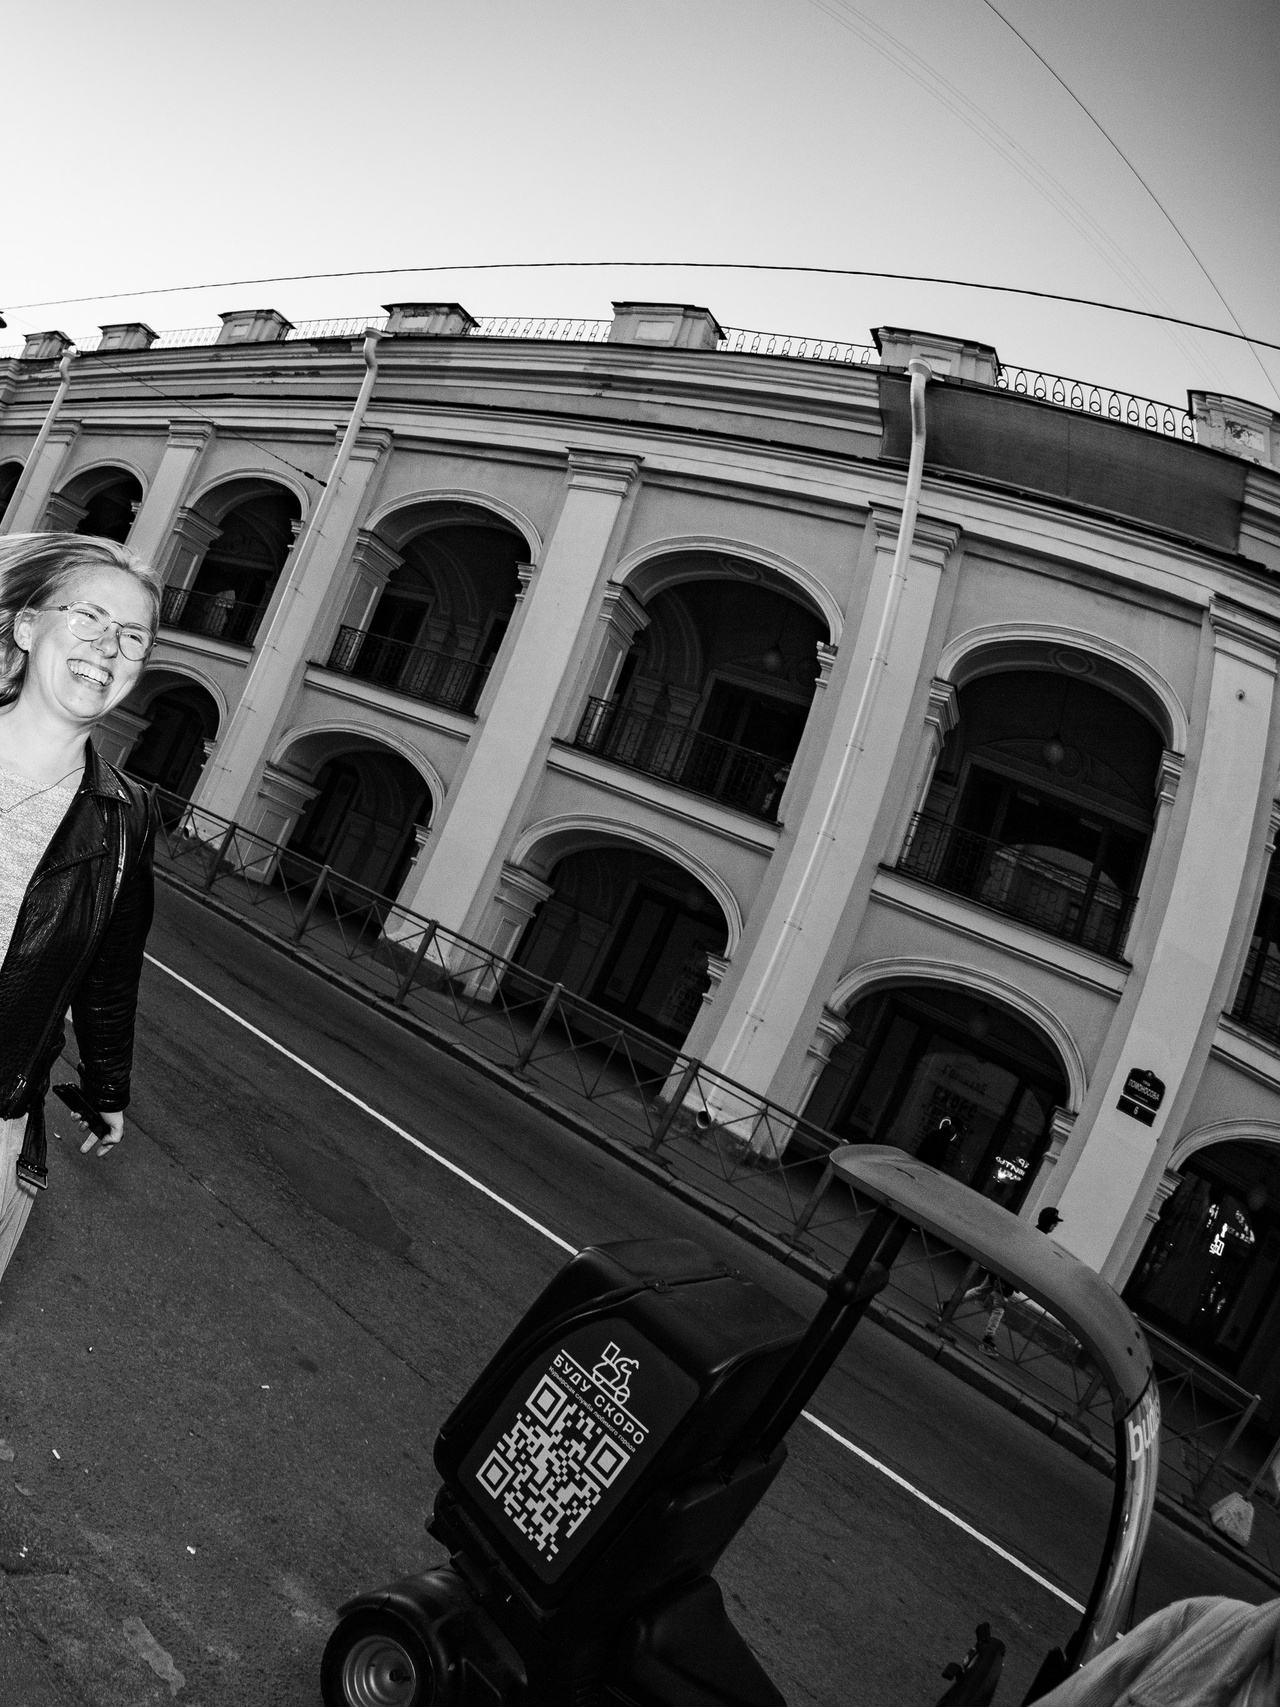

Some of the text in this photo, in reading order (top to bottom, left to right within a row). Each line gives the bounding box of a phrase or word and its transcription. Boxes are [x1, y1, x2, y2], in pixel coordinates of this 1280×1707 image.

[548, 1366, 636, 1453] Курьерская служба любимого города
[553, 1354, 644, 1444] БУДУ СКОРО
